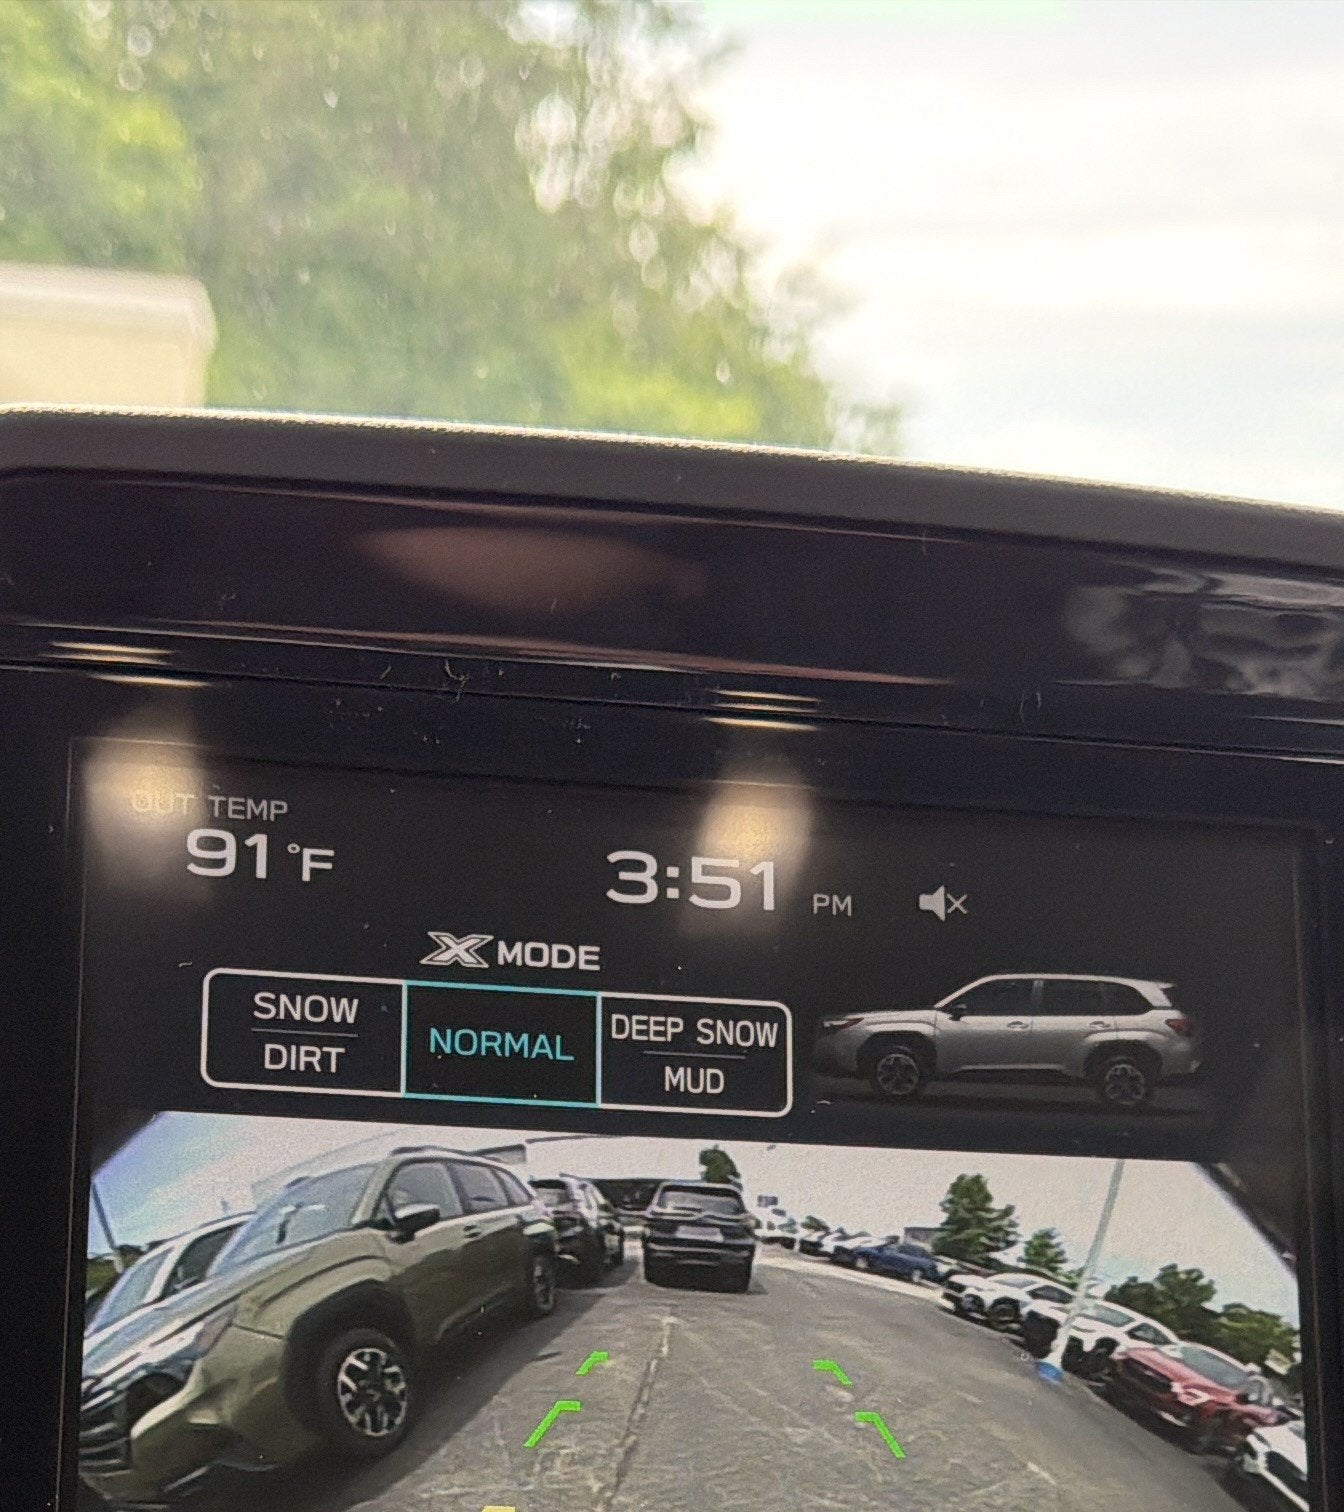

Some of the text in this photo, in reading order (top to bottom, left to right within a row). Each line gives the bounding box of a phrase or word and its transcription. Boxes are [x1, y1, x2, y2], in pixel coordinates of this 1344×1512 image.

[131, 790, 288, 822] OUT TEMP
[186, 828, 268, 879] 91
[605, 850, 853, 917] 3:51 PM
[497, 939, 601, 971] MODE
[252, 991, 359, 1024] SNOW
[429, 1027, 575, 1061] NORMAL
[610, 1013, 778, 1048] DEEP SNOW
[264, 1043, 346, 1073] DIRT
[664, 1065, 725, 1094] MUD
